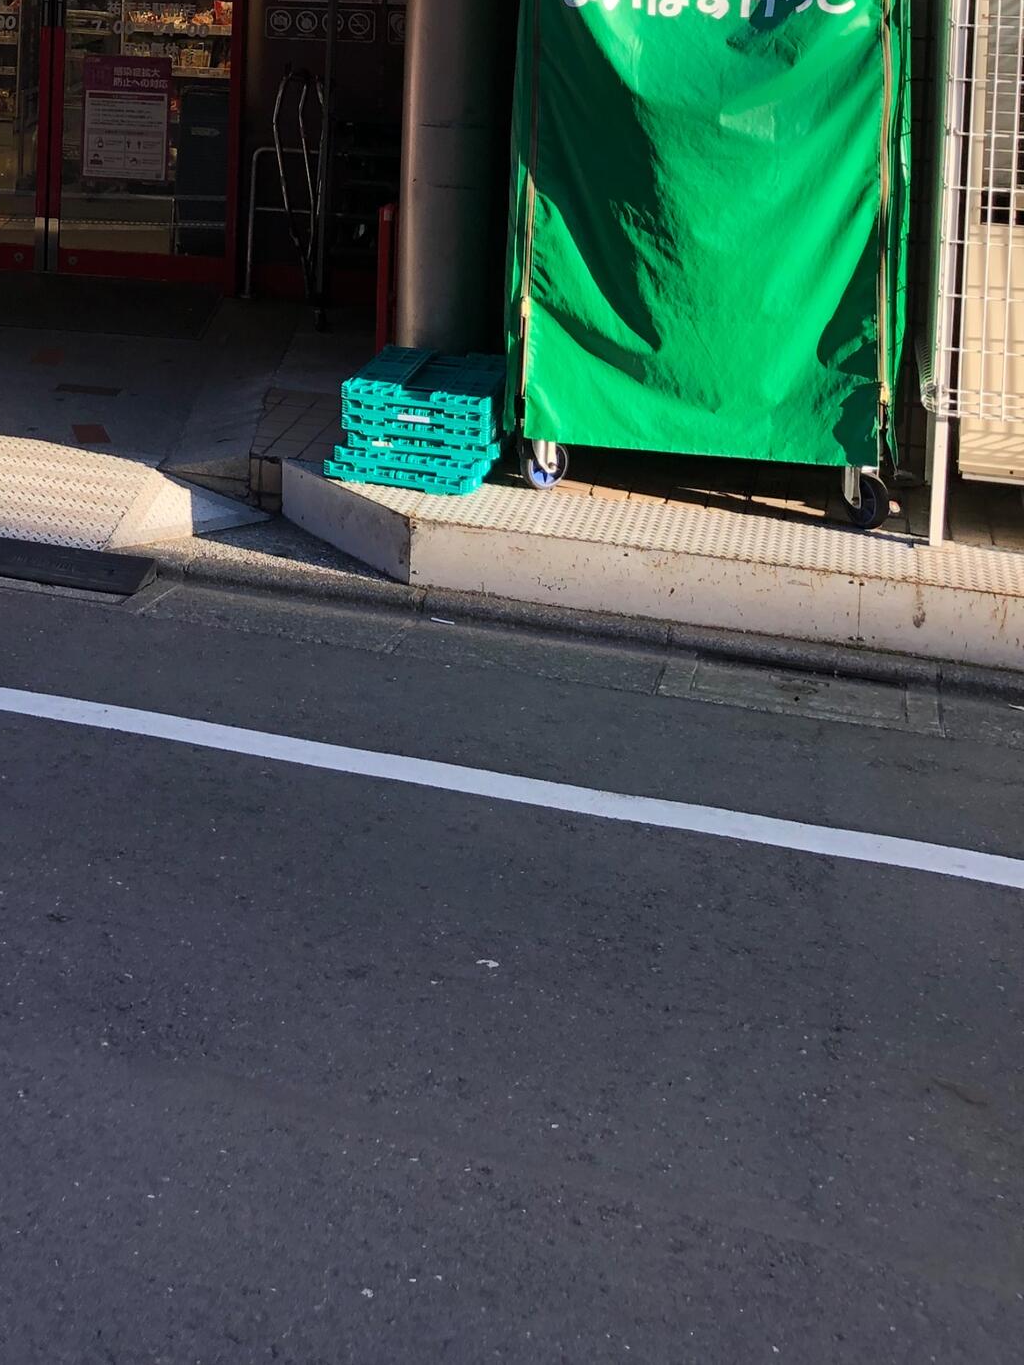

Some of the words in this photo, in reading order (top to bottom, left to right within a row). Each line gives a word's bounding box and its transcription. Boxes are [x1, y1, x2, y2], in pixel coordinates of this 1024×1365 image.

[113, 77, 168, 89] 防止への対応
